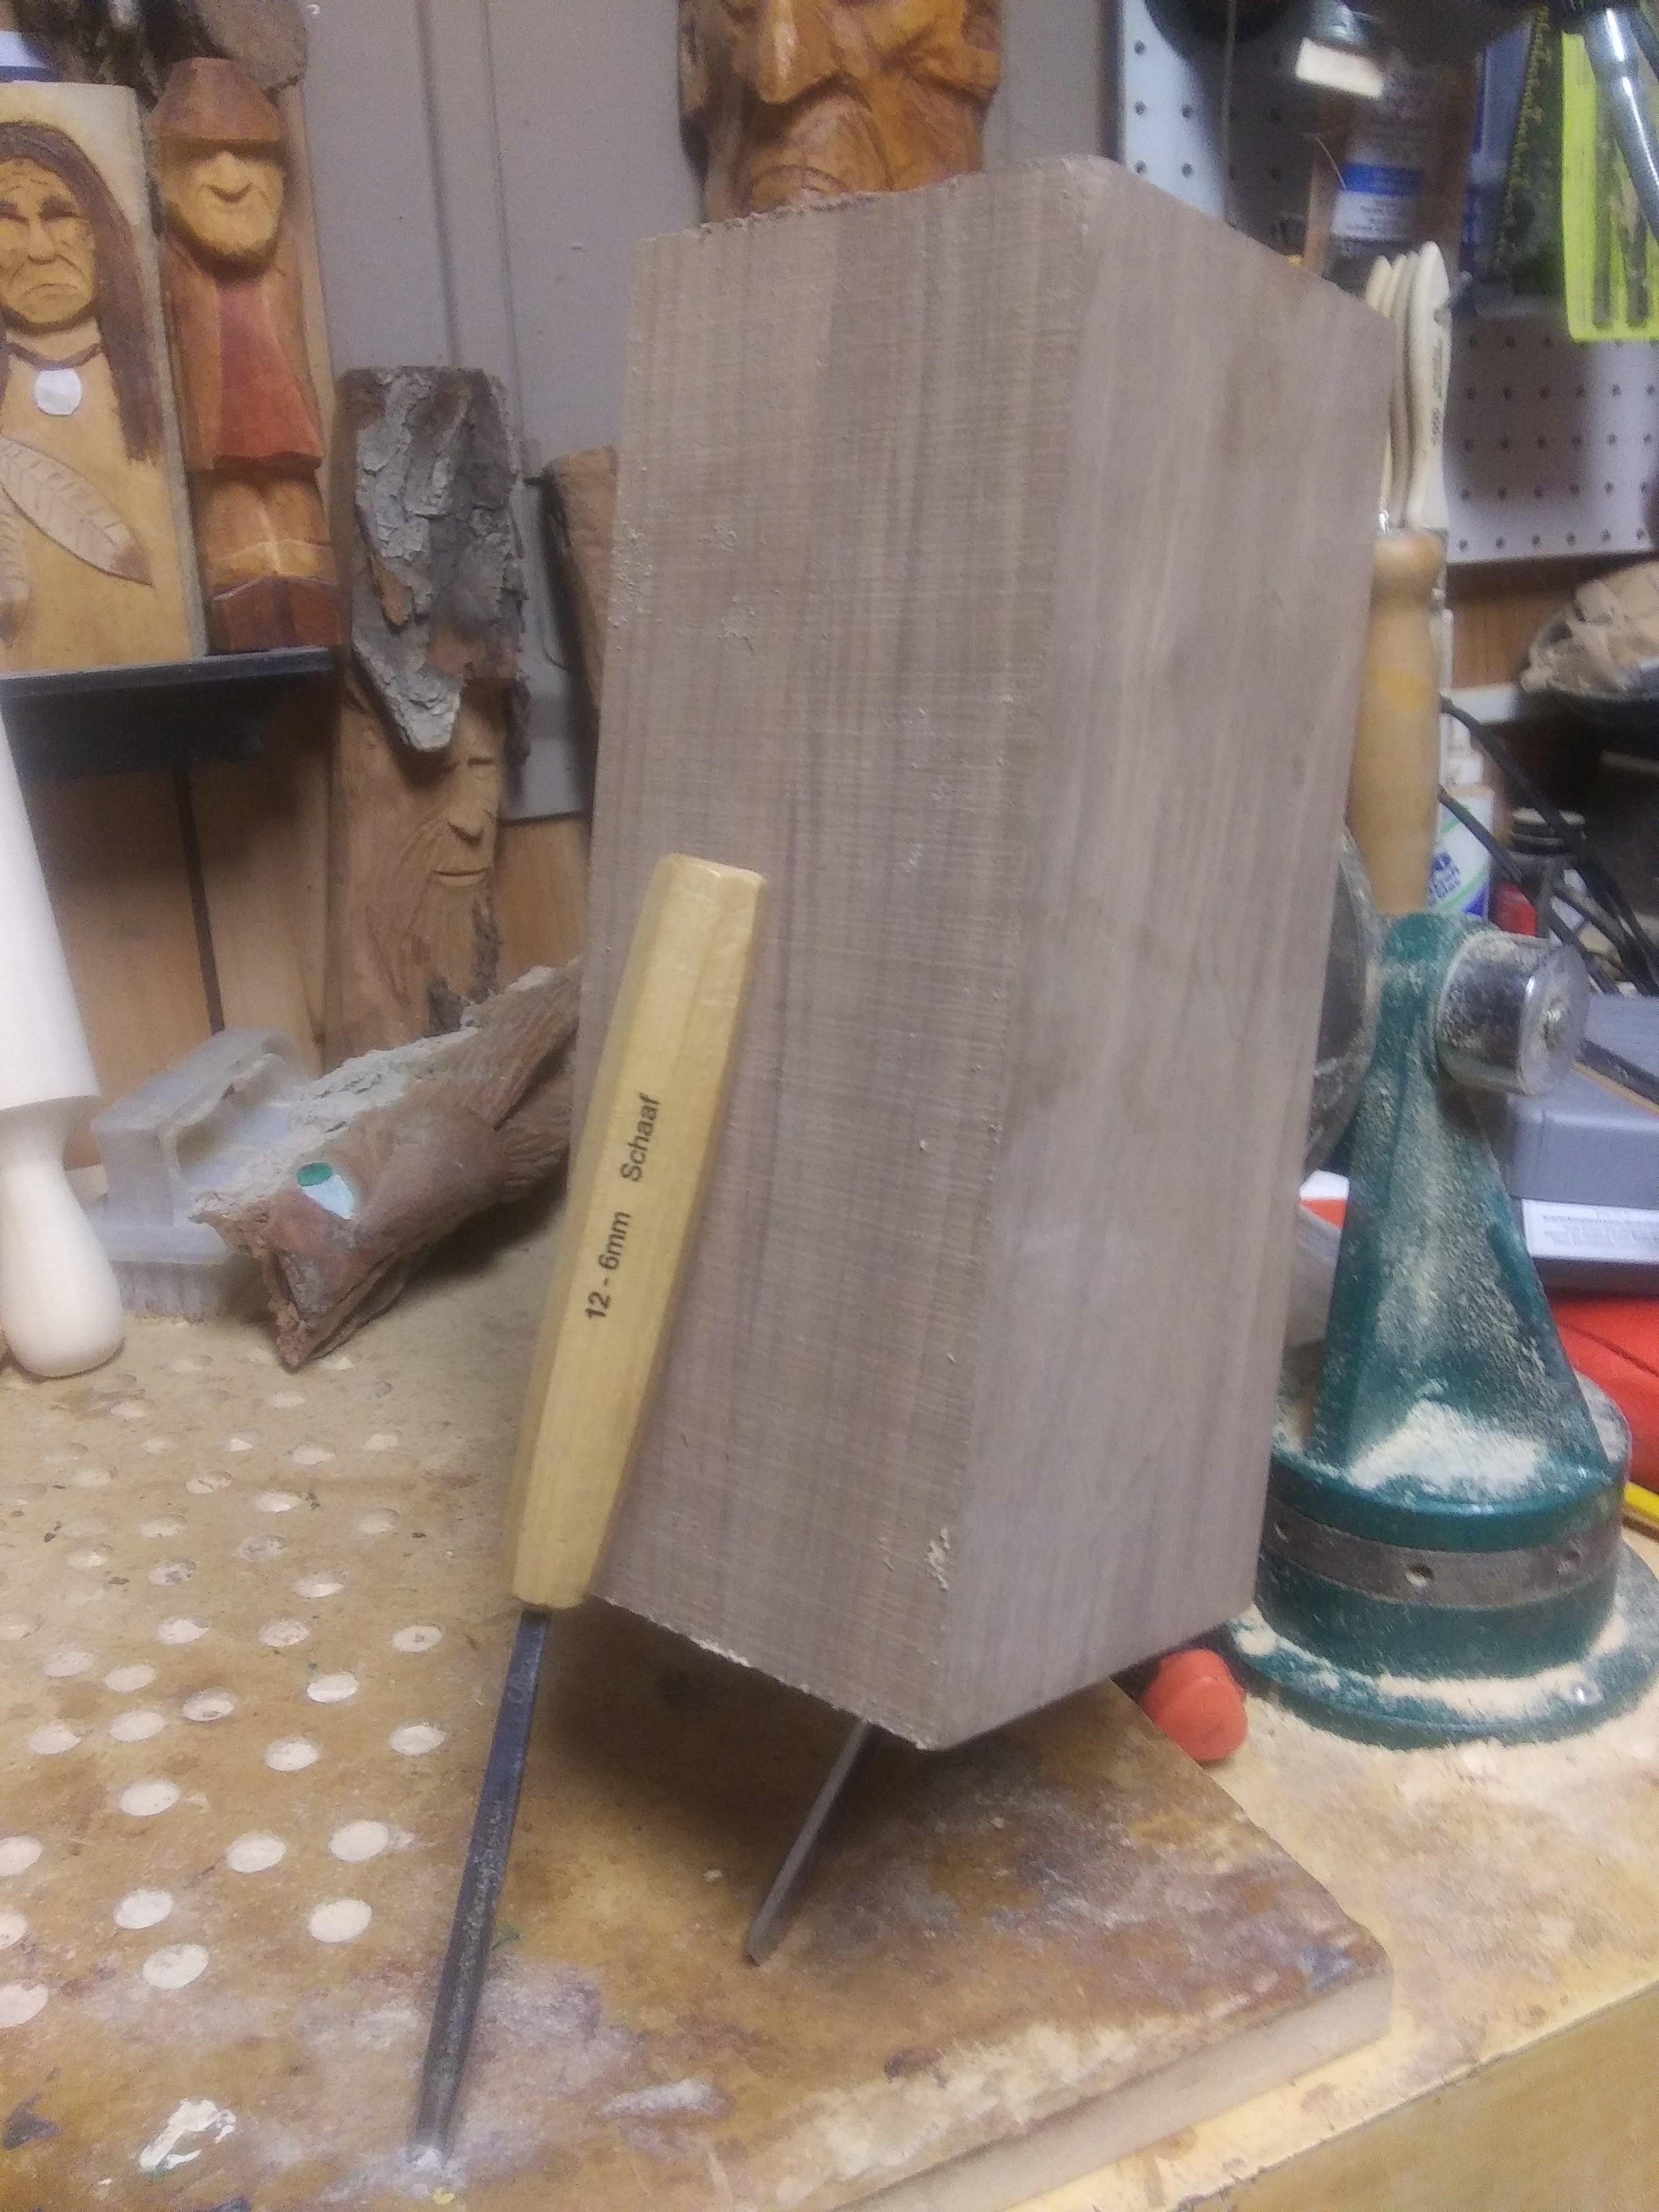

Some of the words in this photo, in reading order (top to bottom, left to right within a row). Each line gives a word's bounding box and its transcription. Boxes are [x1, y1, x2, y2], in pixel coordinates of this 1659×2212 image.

[585, 1291, 611, 1320] 12
[598, 1211, 631, 1271] 6mm
[620, 1091, 661, 1183] Schaaf
